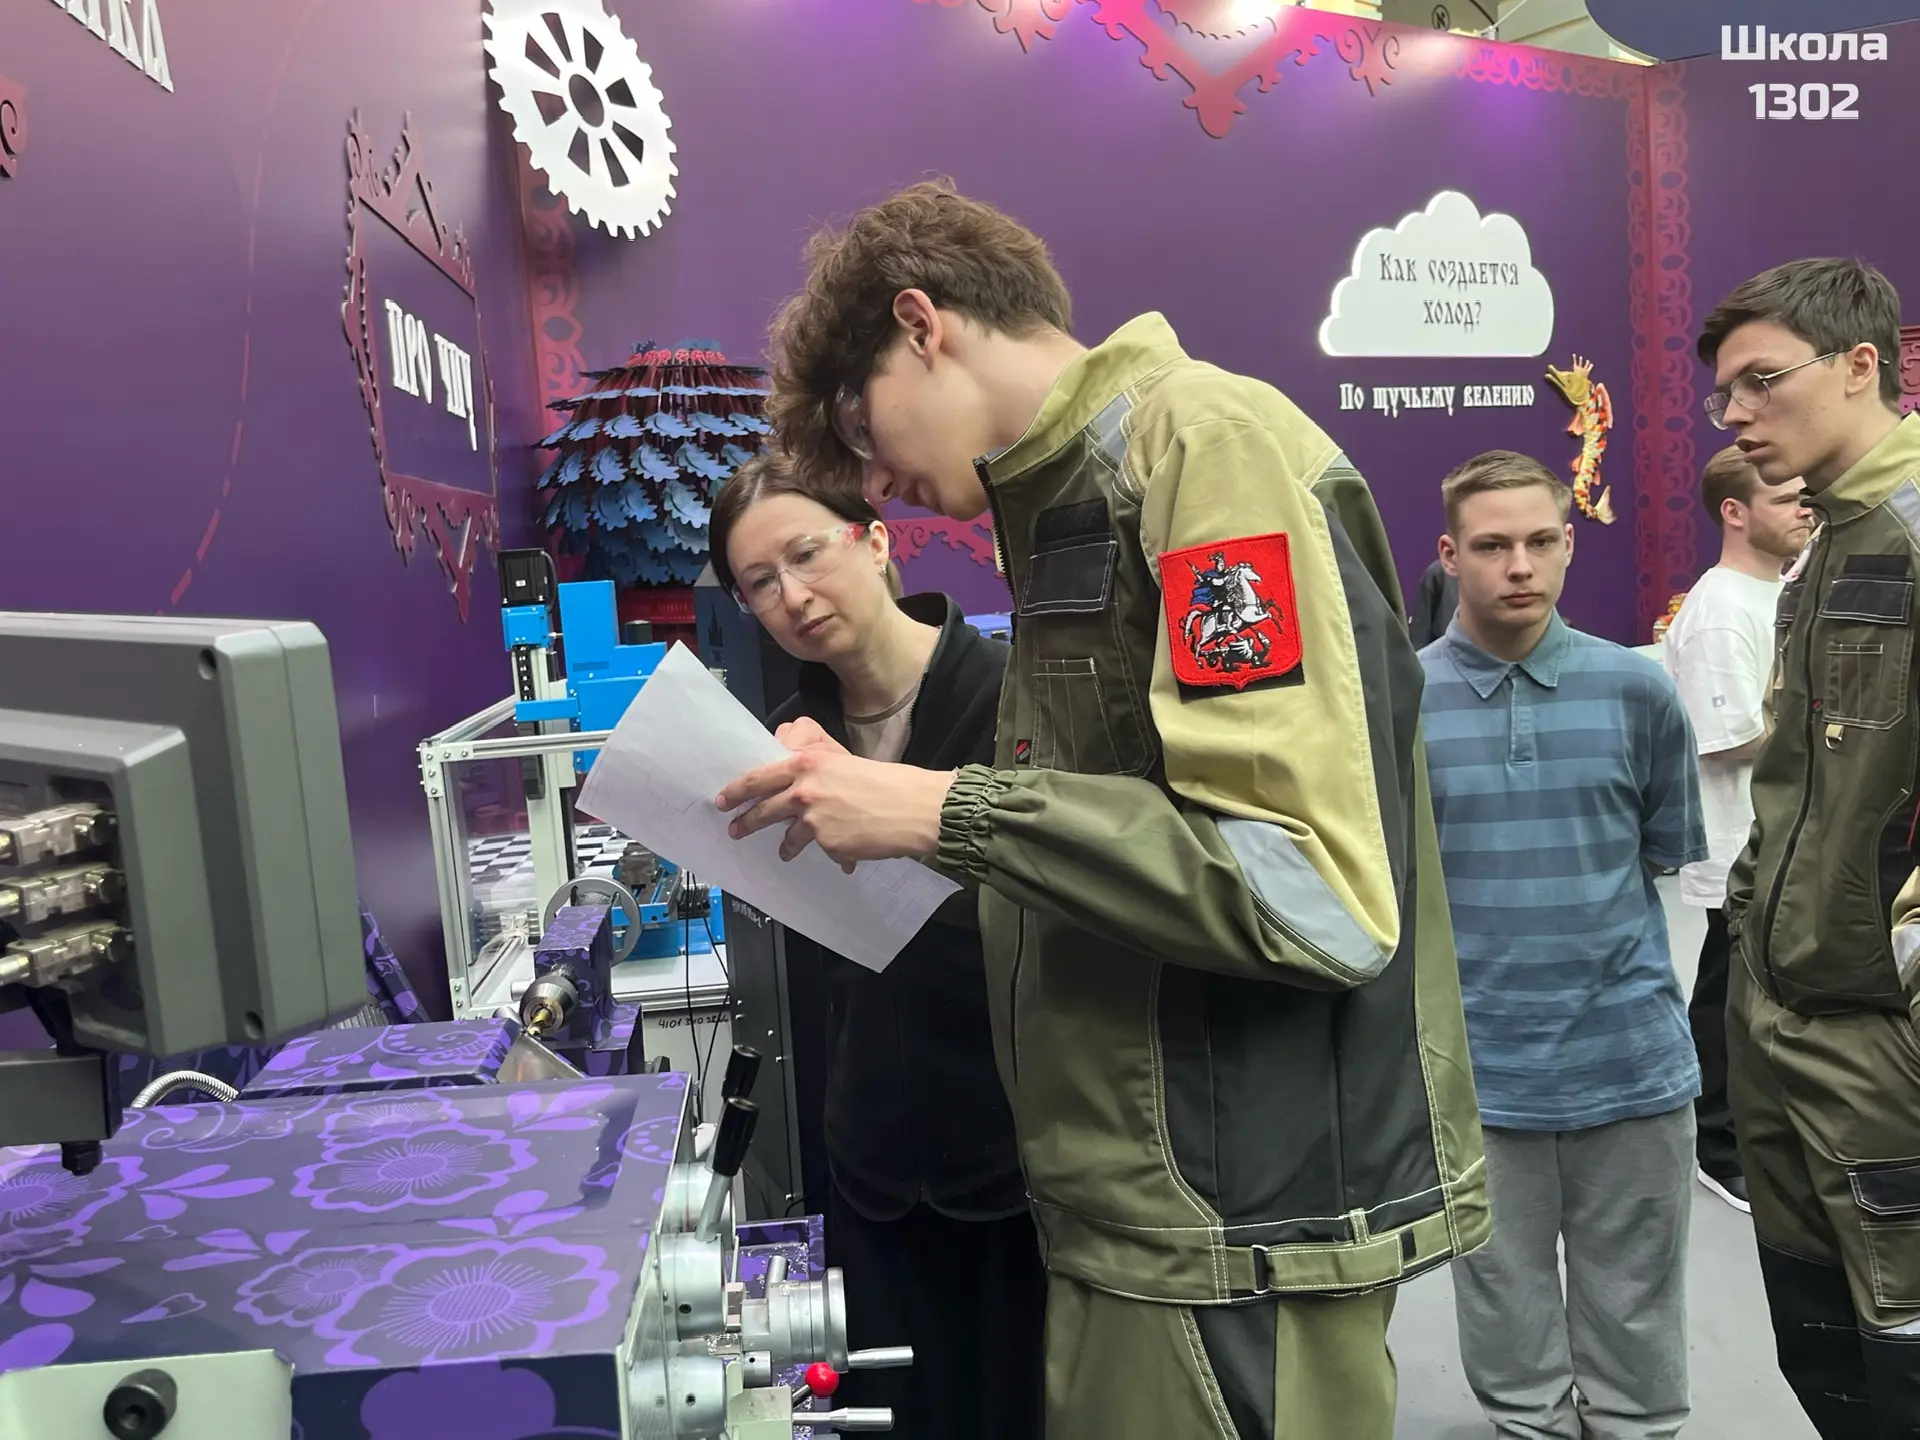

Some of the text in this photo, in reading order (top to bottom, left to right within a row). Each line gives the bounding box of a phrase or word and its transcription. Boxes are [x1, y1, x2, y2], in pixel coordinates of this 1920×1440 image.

[1379, 253, 1418, 282] Как
[385, 299, 432, 405] ПРО
[1340, 383, 1365, 410] По
